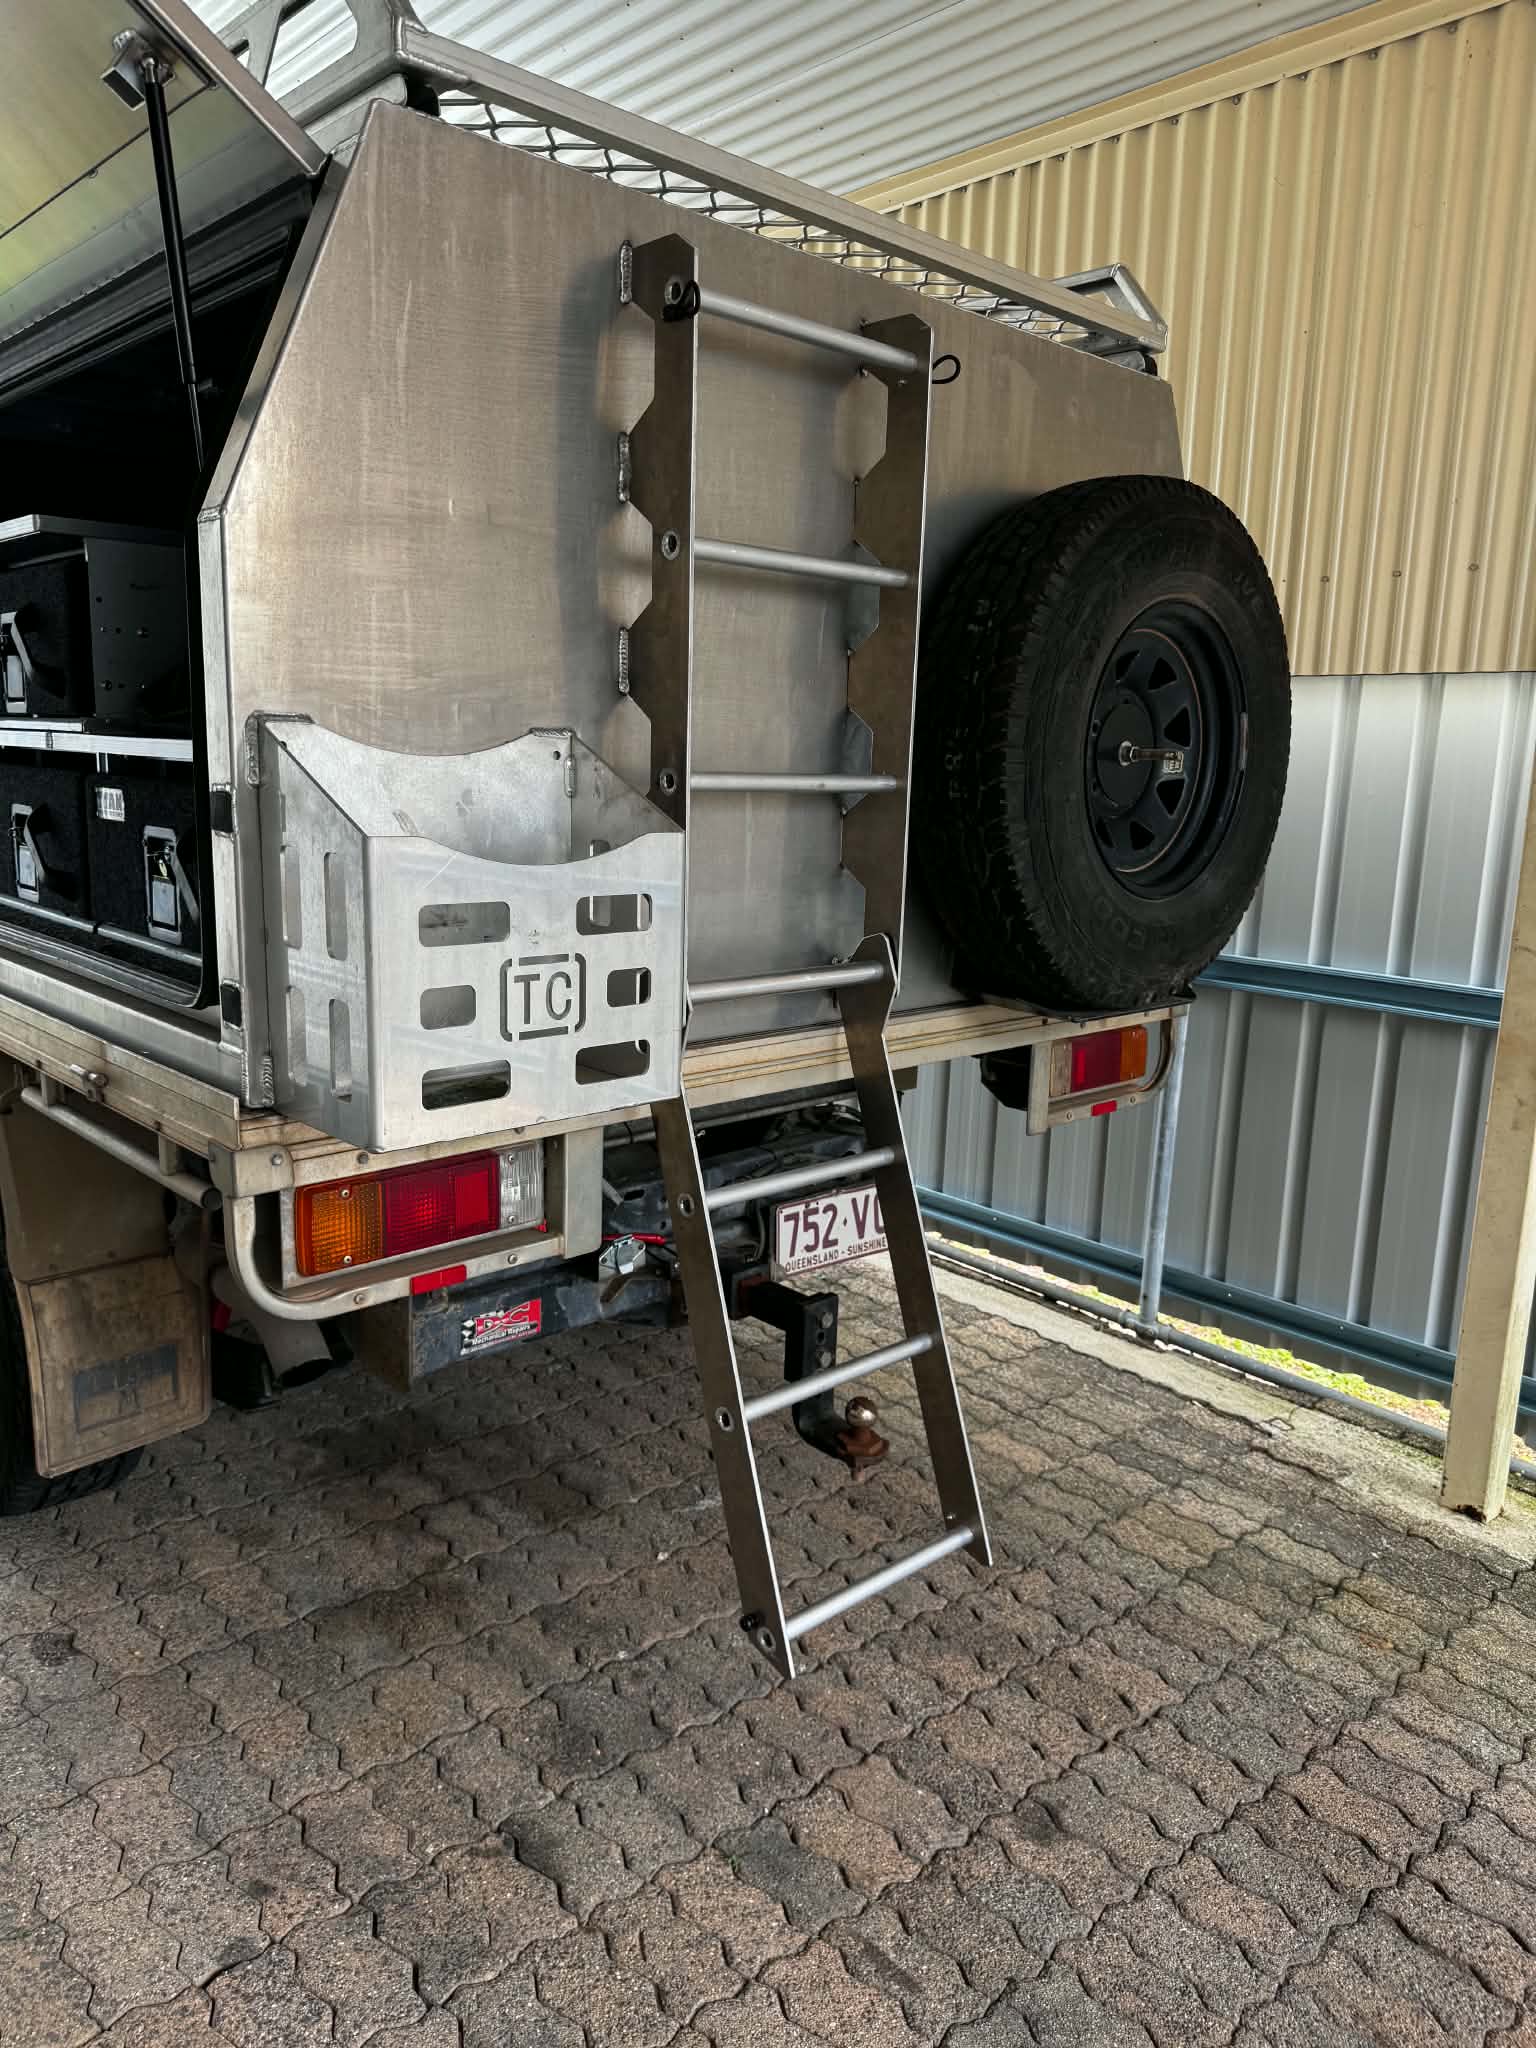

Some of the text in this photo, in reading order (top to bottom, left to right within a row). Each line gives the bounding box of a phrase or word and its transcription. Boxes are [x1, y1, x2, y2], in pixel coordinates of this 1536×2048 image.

[514, 971, 572, 1024] TC
[783, 1203, 839, 1258] 752
[785, 1249, 839, 1273] QUEENSLAND
[847, 1236, 887, 1256] SUNSHINE
